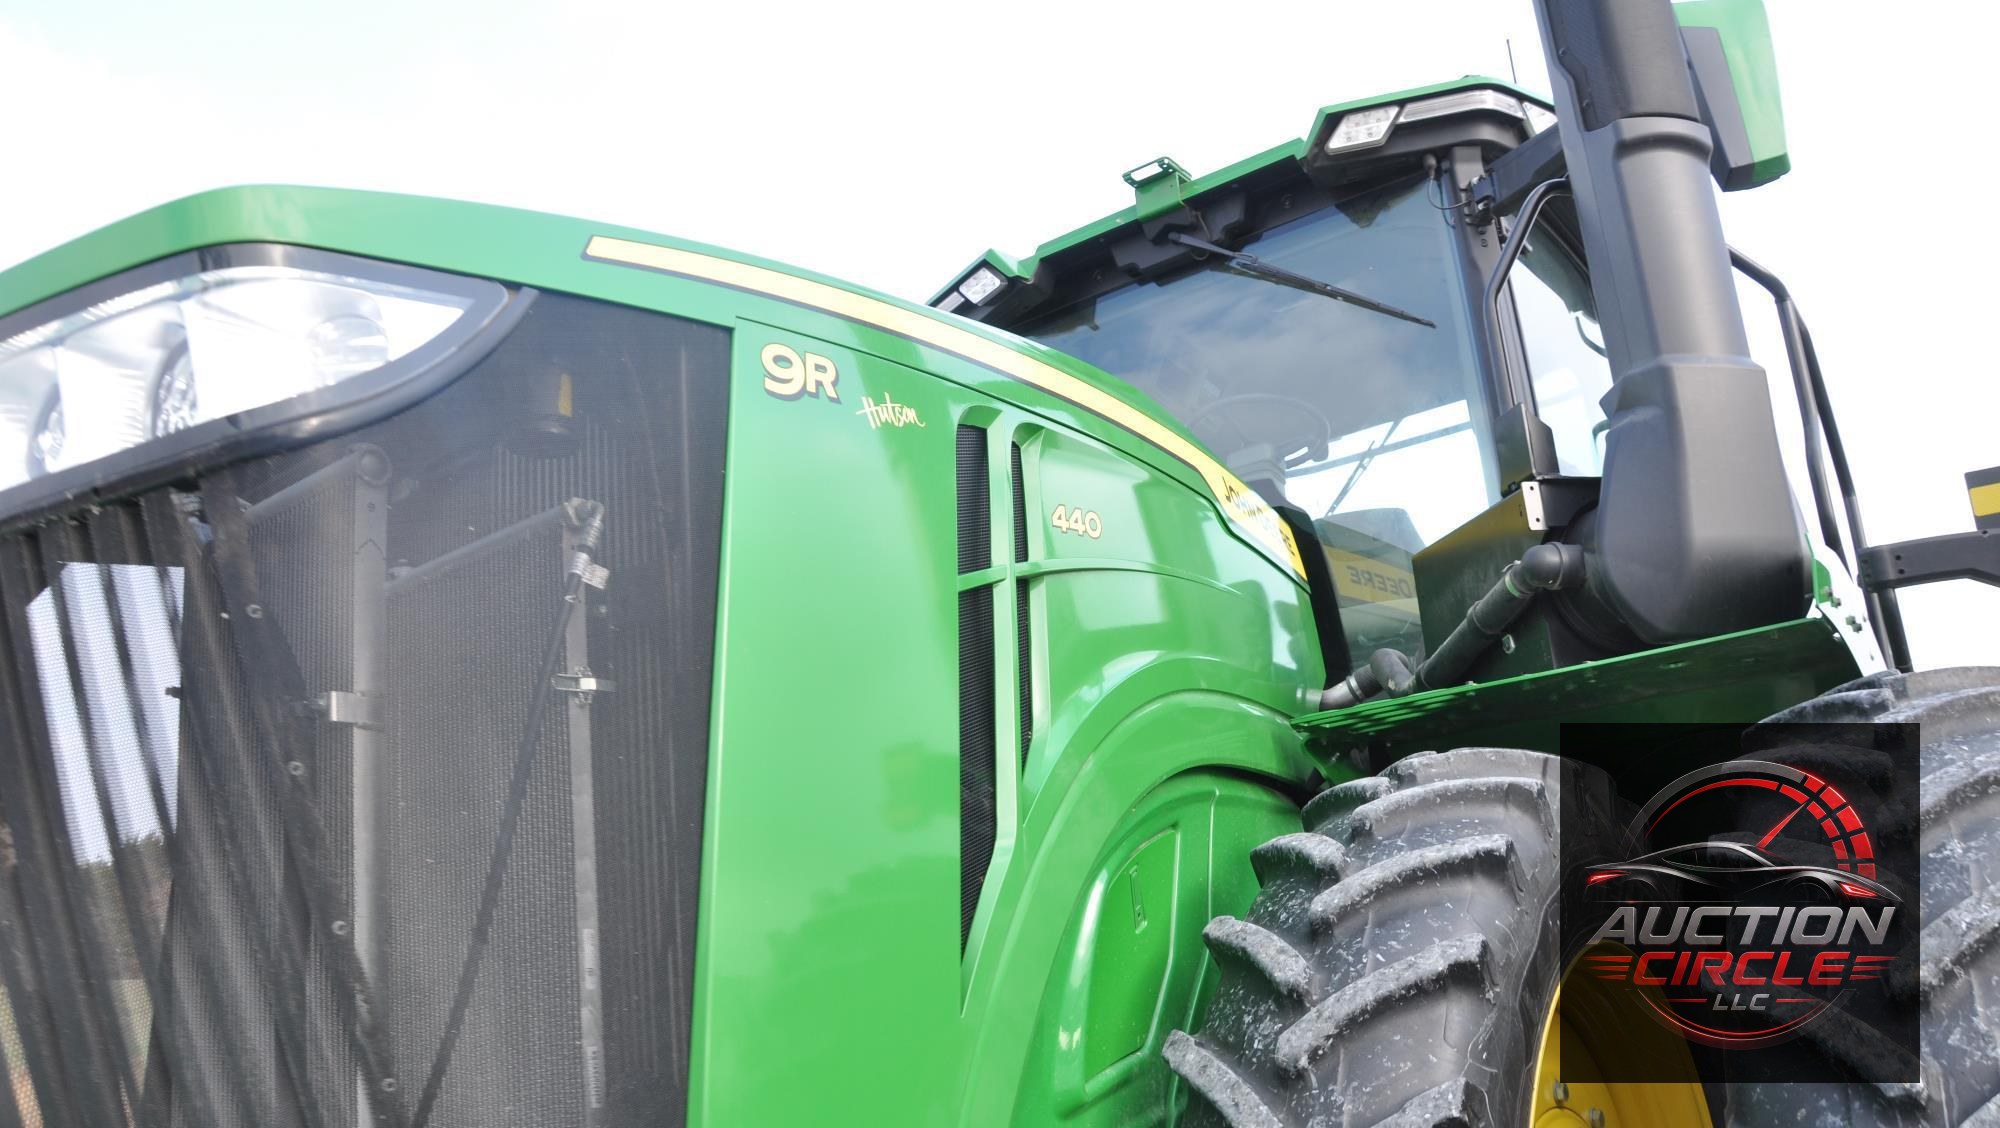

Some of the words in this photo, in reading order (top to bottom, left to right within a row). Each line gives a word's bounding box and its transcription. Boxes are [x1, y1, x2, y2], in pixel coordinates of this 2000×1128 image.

[760, 342, 841, 404] 9R
[856, 392, 926, 429] Hutson
[1051, 504, 1103, 539] 440
